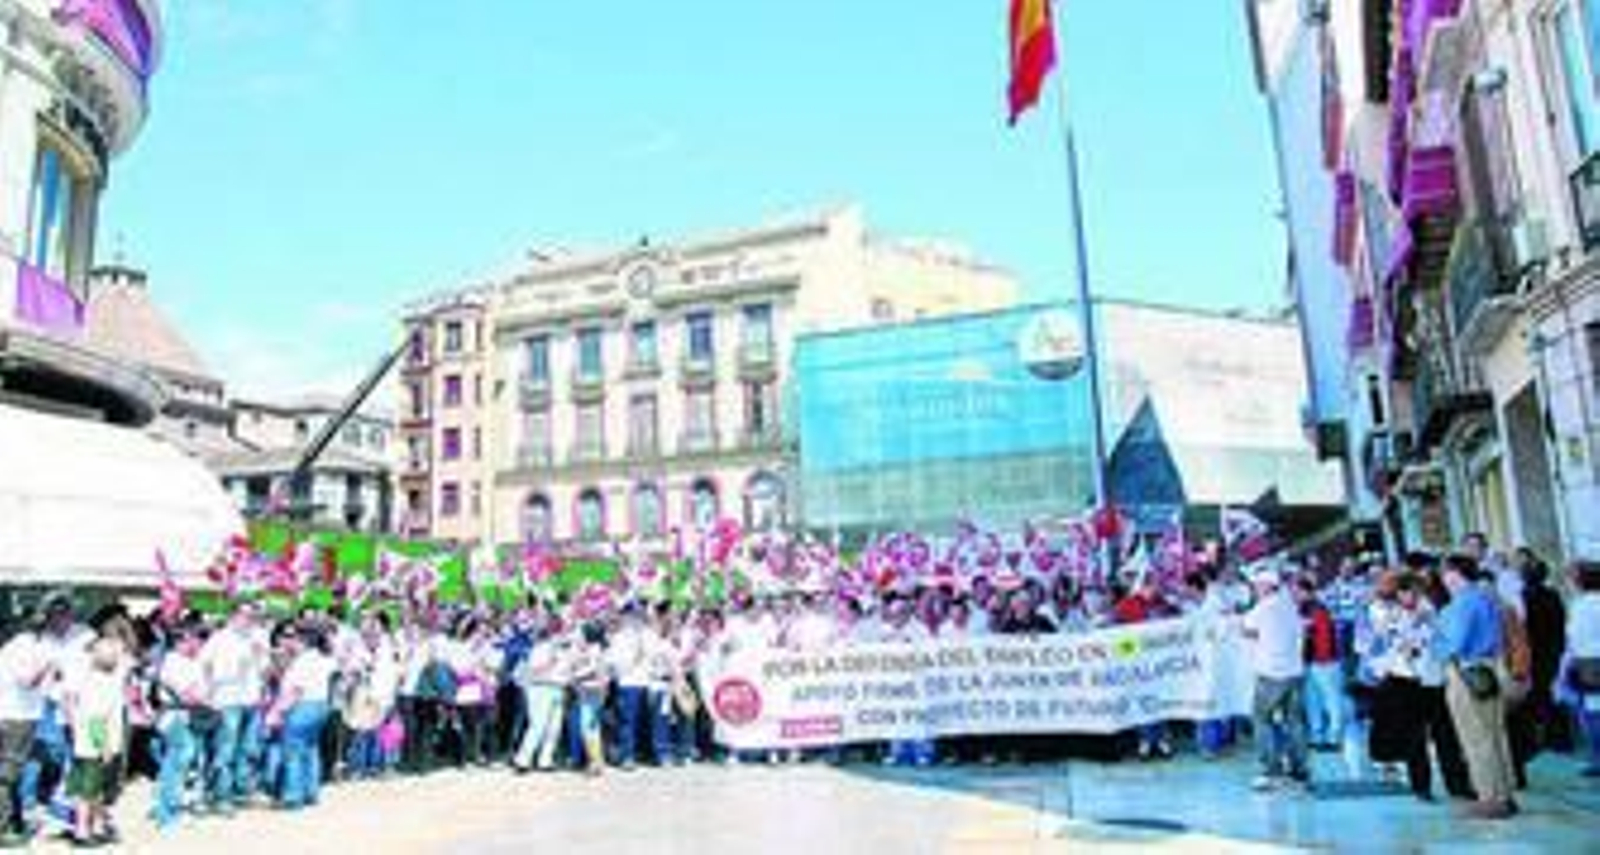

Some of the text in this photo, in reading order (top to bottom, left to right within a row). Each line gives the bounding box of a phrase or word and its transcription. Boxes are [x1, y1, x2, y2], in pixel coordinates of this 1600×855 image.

[958, 672, 983, 691] LA
[990, 670, 1050, 689] JUNTA
[857, 708, 897, 726] CON
